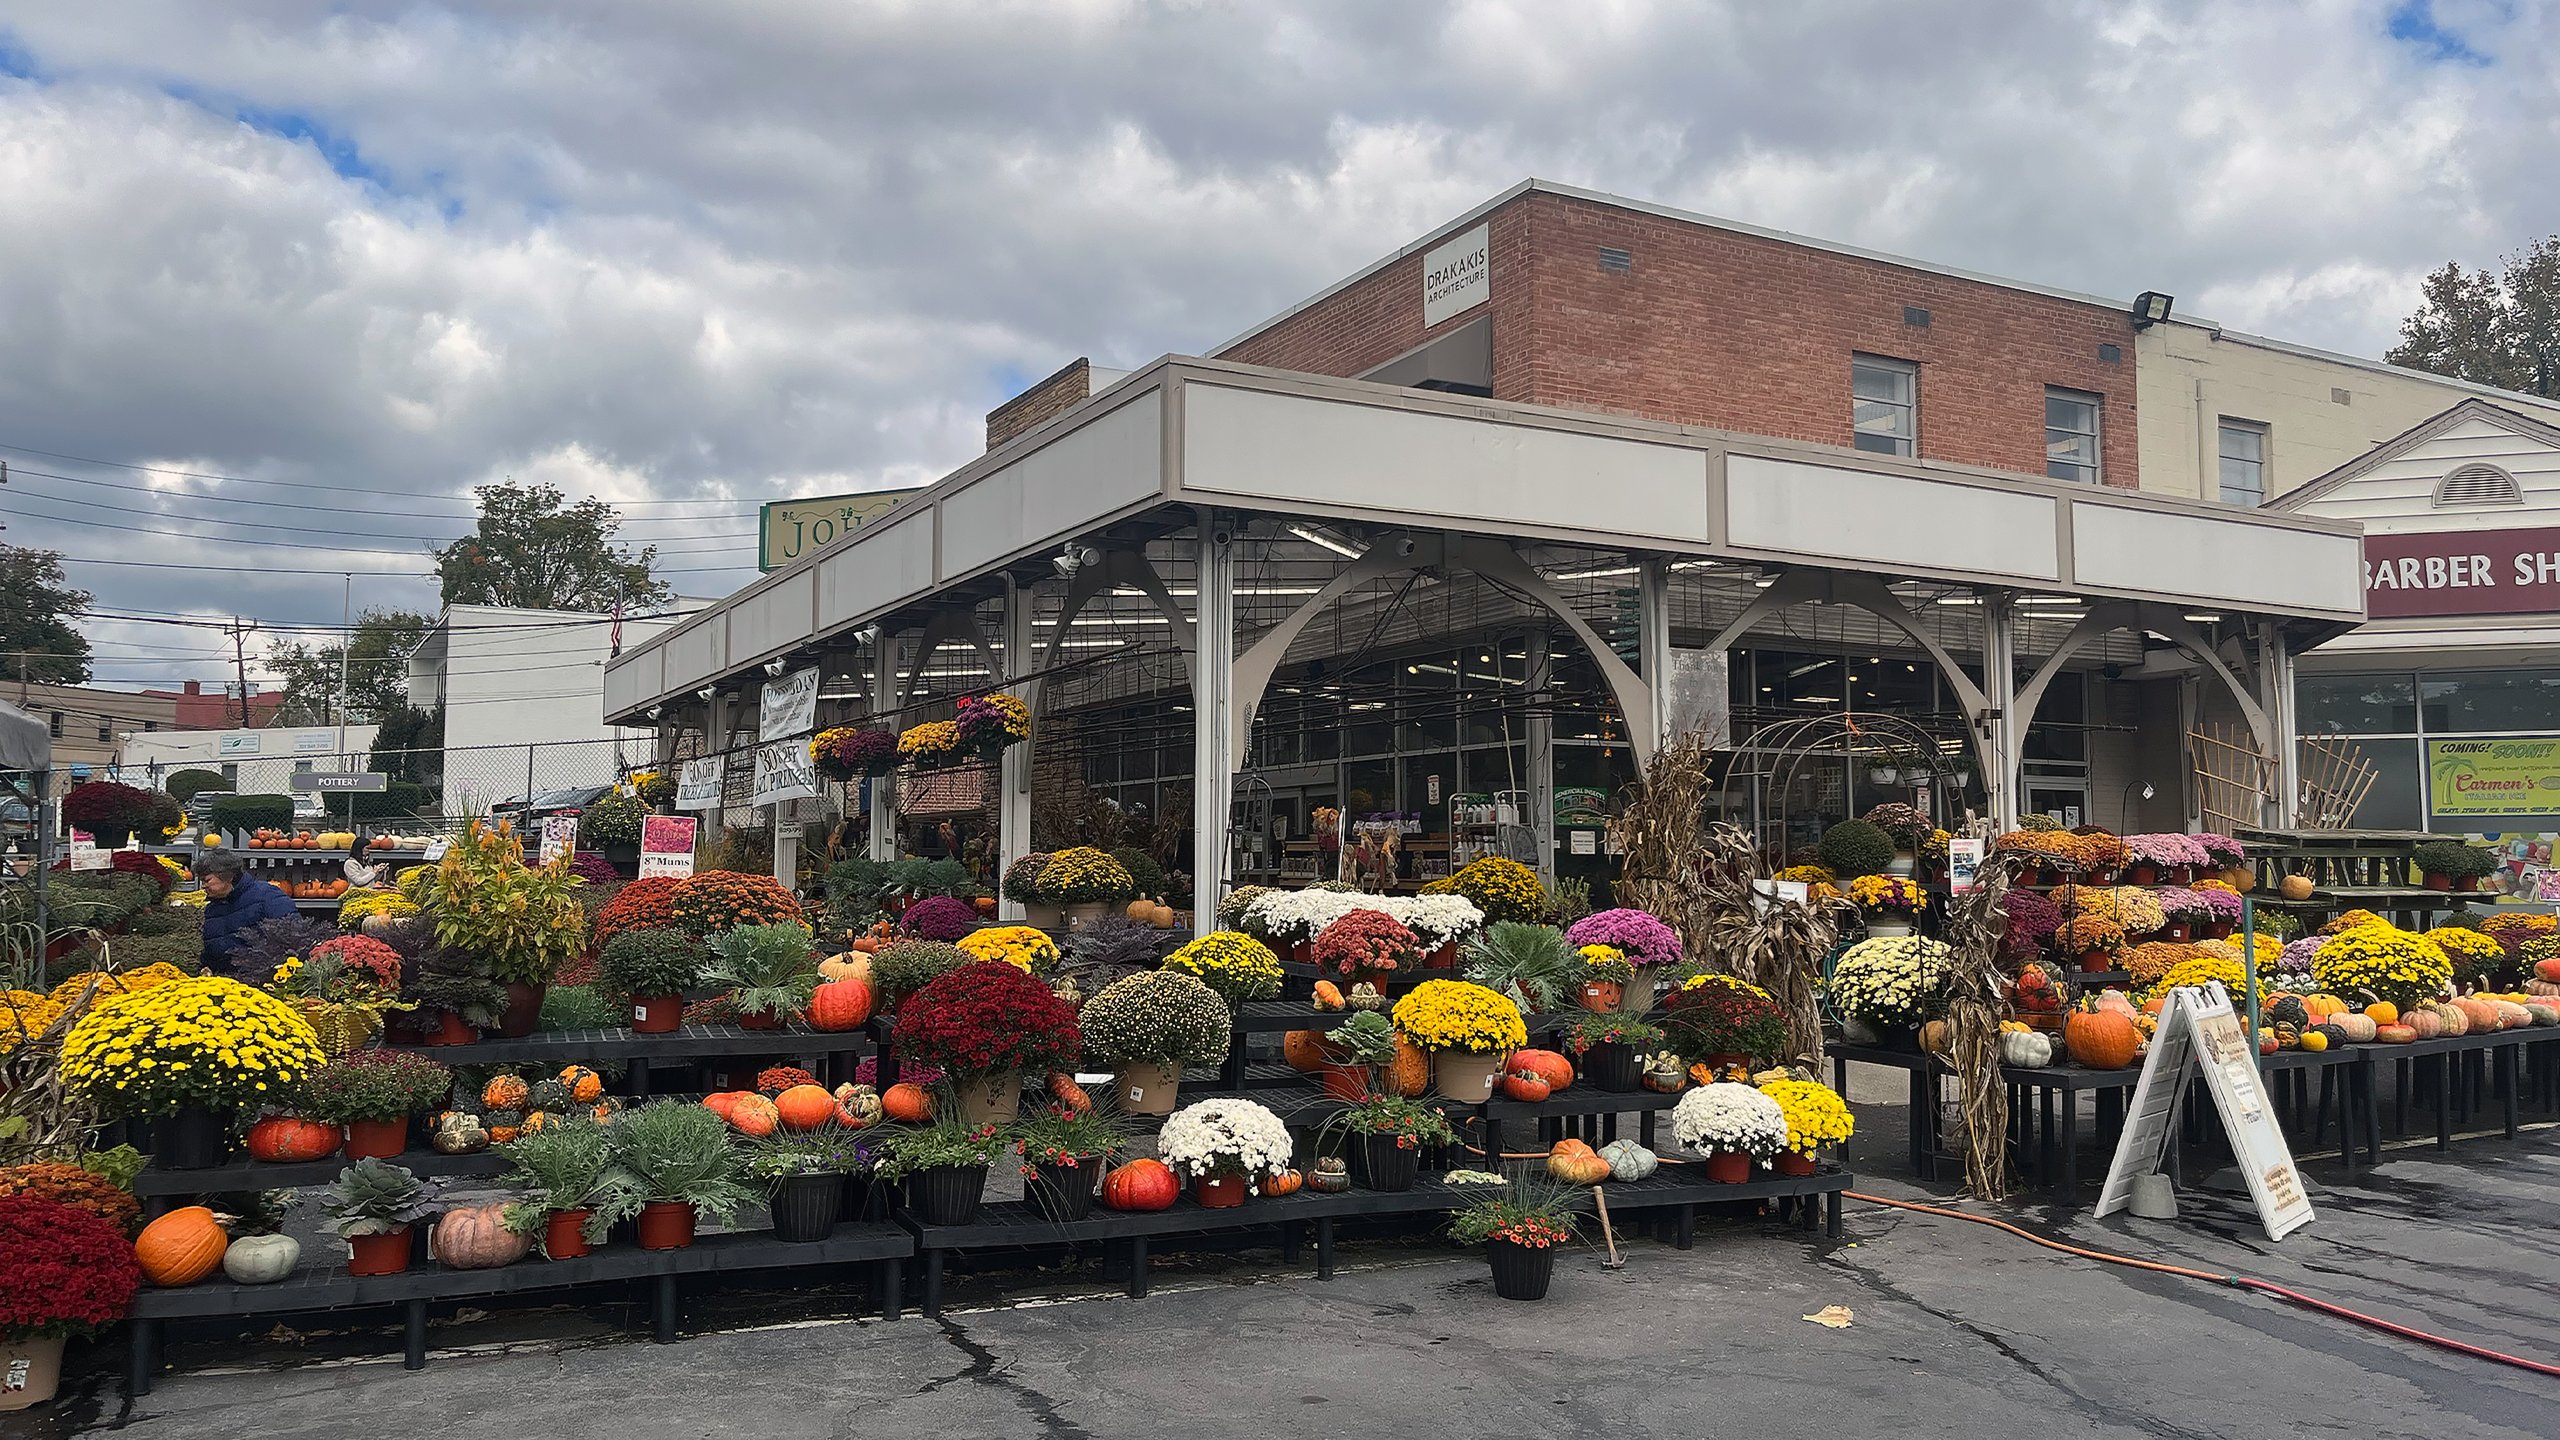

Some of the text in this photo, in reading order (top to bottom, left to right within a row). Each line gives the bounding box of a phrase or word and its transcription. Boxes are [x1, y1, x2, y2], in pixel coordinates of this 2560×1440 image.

[1427, 248, 1485, 291] DRAKAKIS
[1427, 268, 1485, 305] ARCHITECTURE
[2440, 742, 2556, 760] COMING! SOON!!
[317, 777, 361, 787] POTTERY
[2455, 773, 2536, 793] Carmen's
[656, 857, 690, 867] Mums
